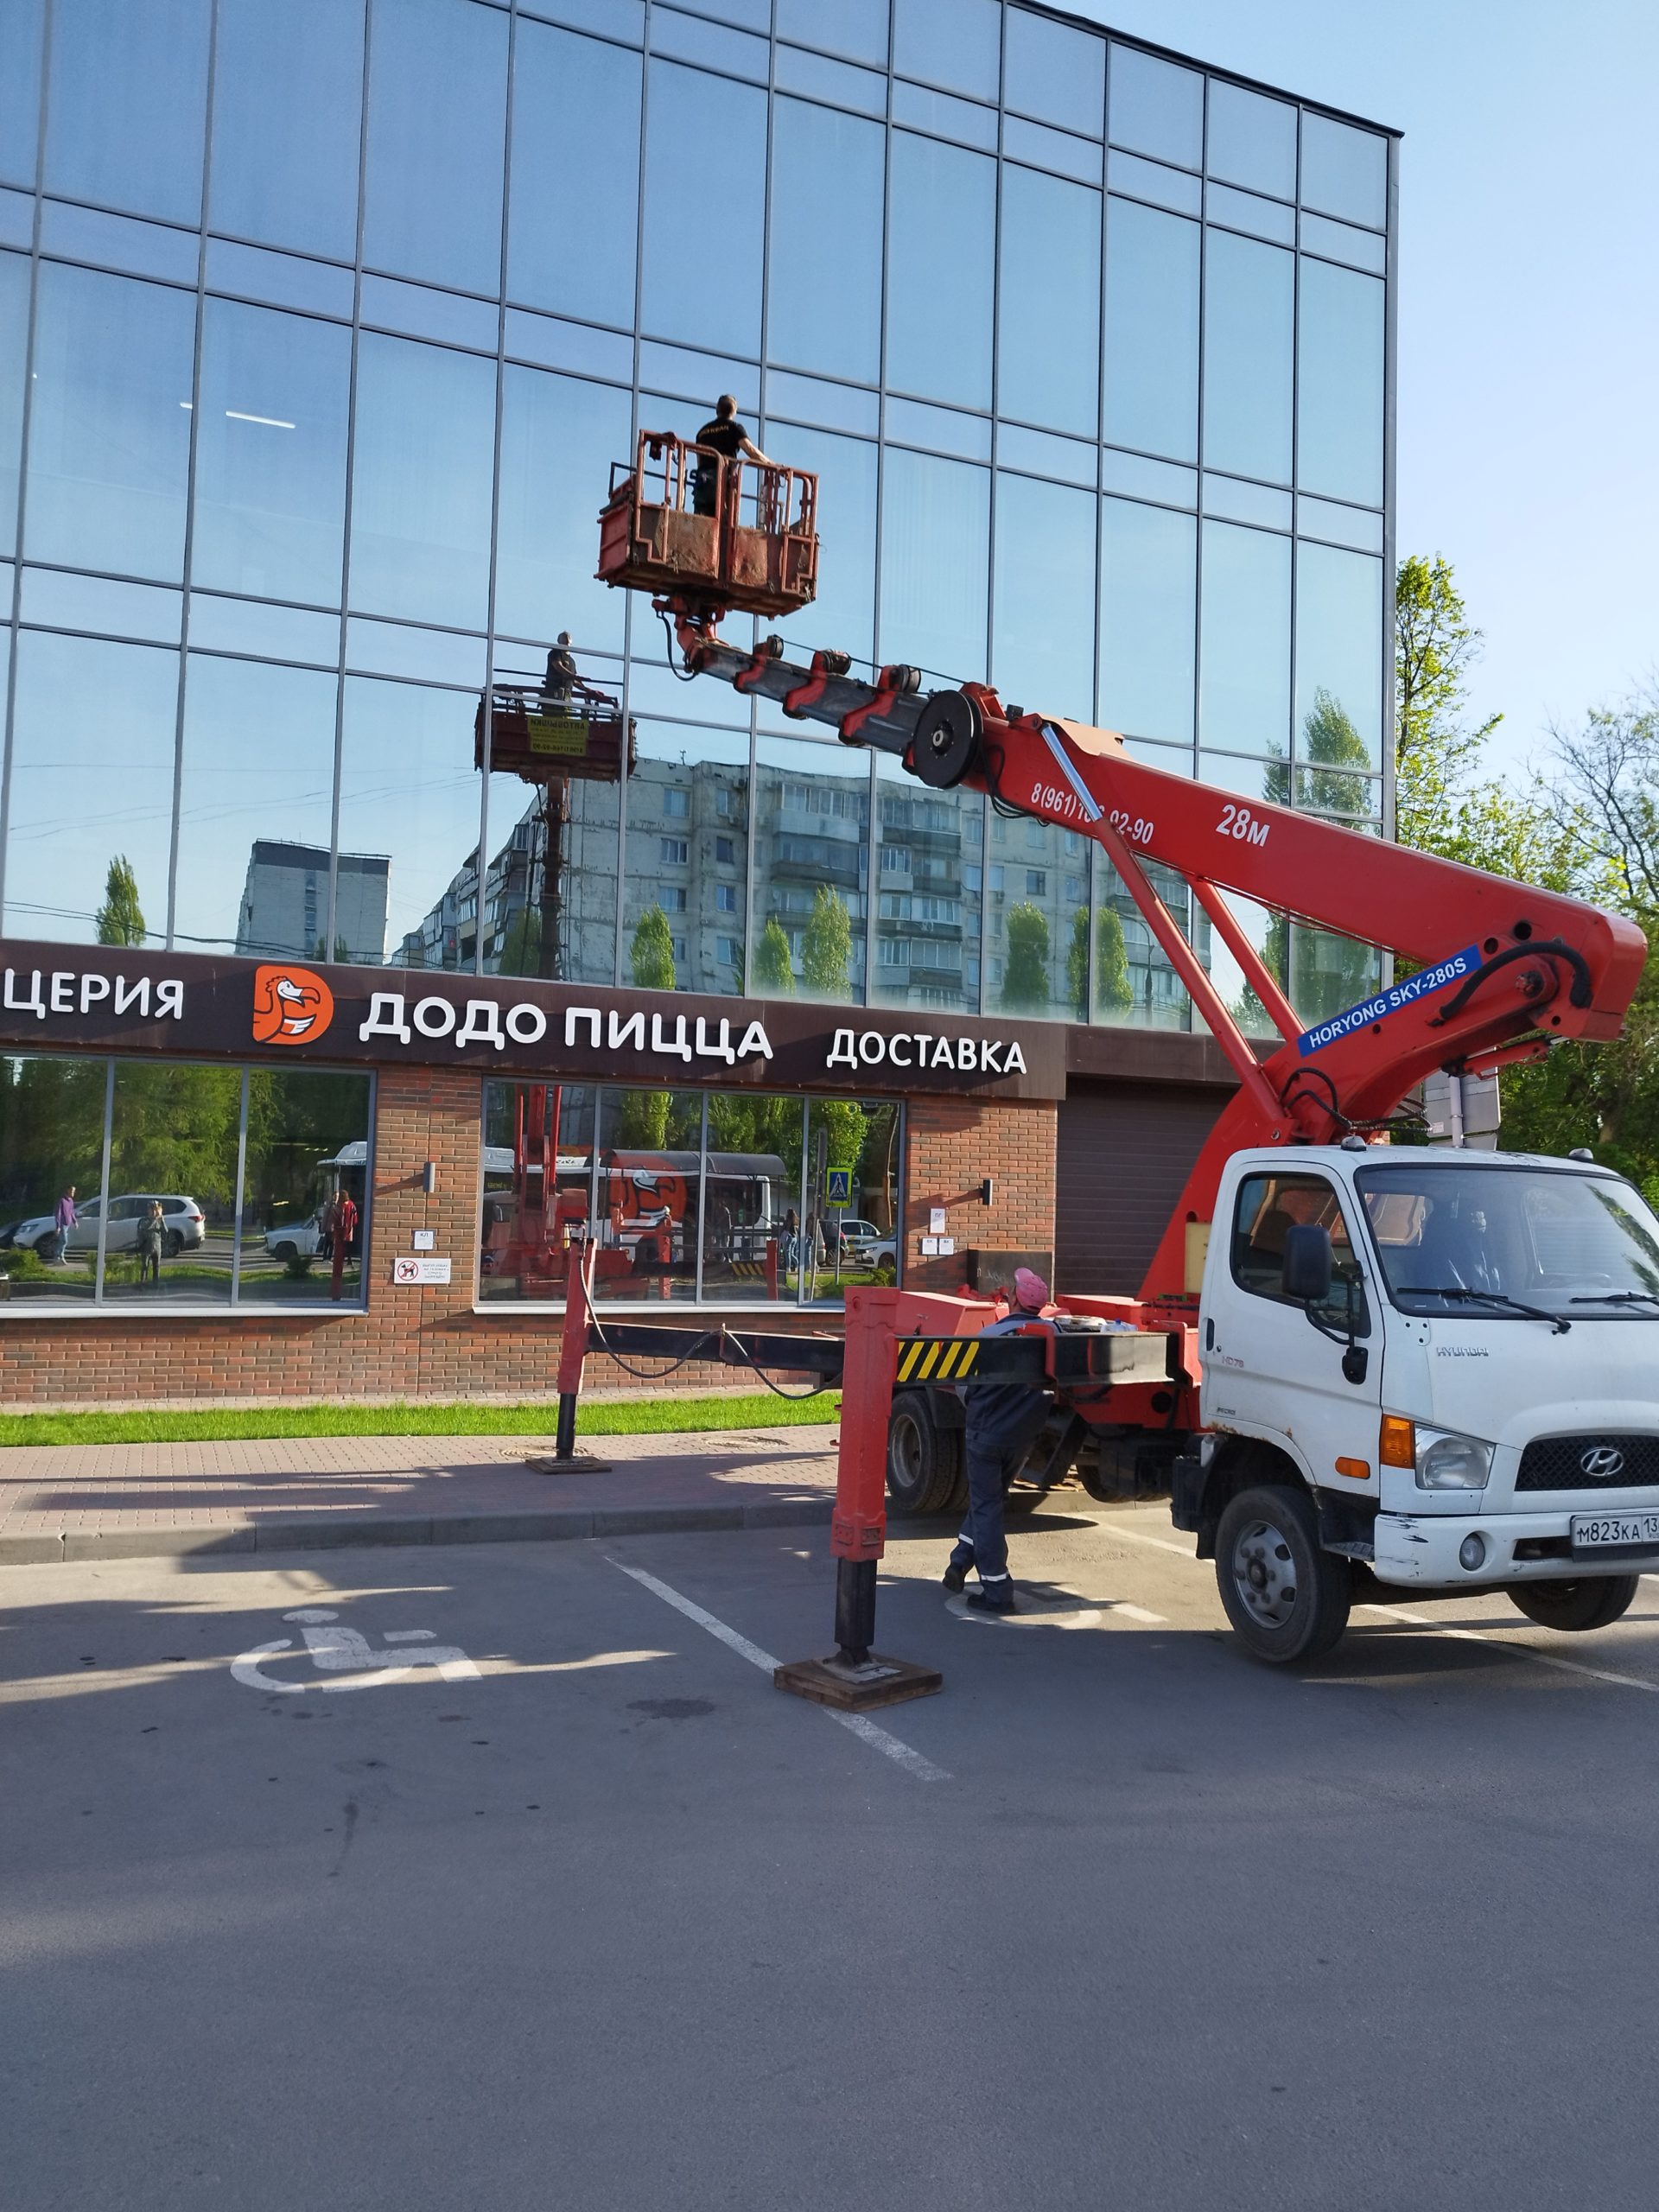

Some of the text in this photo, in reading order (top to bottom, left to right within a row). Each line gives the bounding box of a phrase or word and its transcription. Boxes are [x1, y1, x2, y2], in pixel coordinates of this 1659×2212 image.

[3, 968, 184, 1020] ЦЕРИЯ
[1309, 957, 1467, 1049] HORYONG SKY-280S
[359, 992, 774, 1065] ДОДО ПИЦЦА
[826, 1028, 1027, 1075] ДОСТАВКА
[1436, 1346, 1489, 1357] HYUNDAI
[1579, 1517, 1659, 1542] М823КА 13
